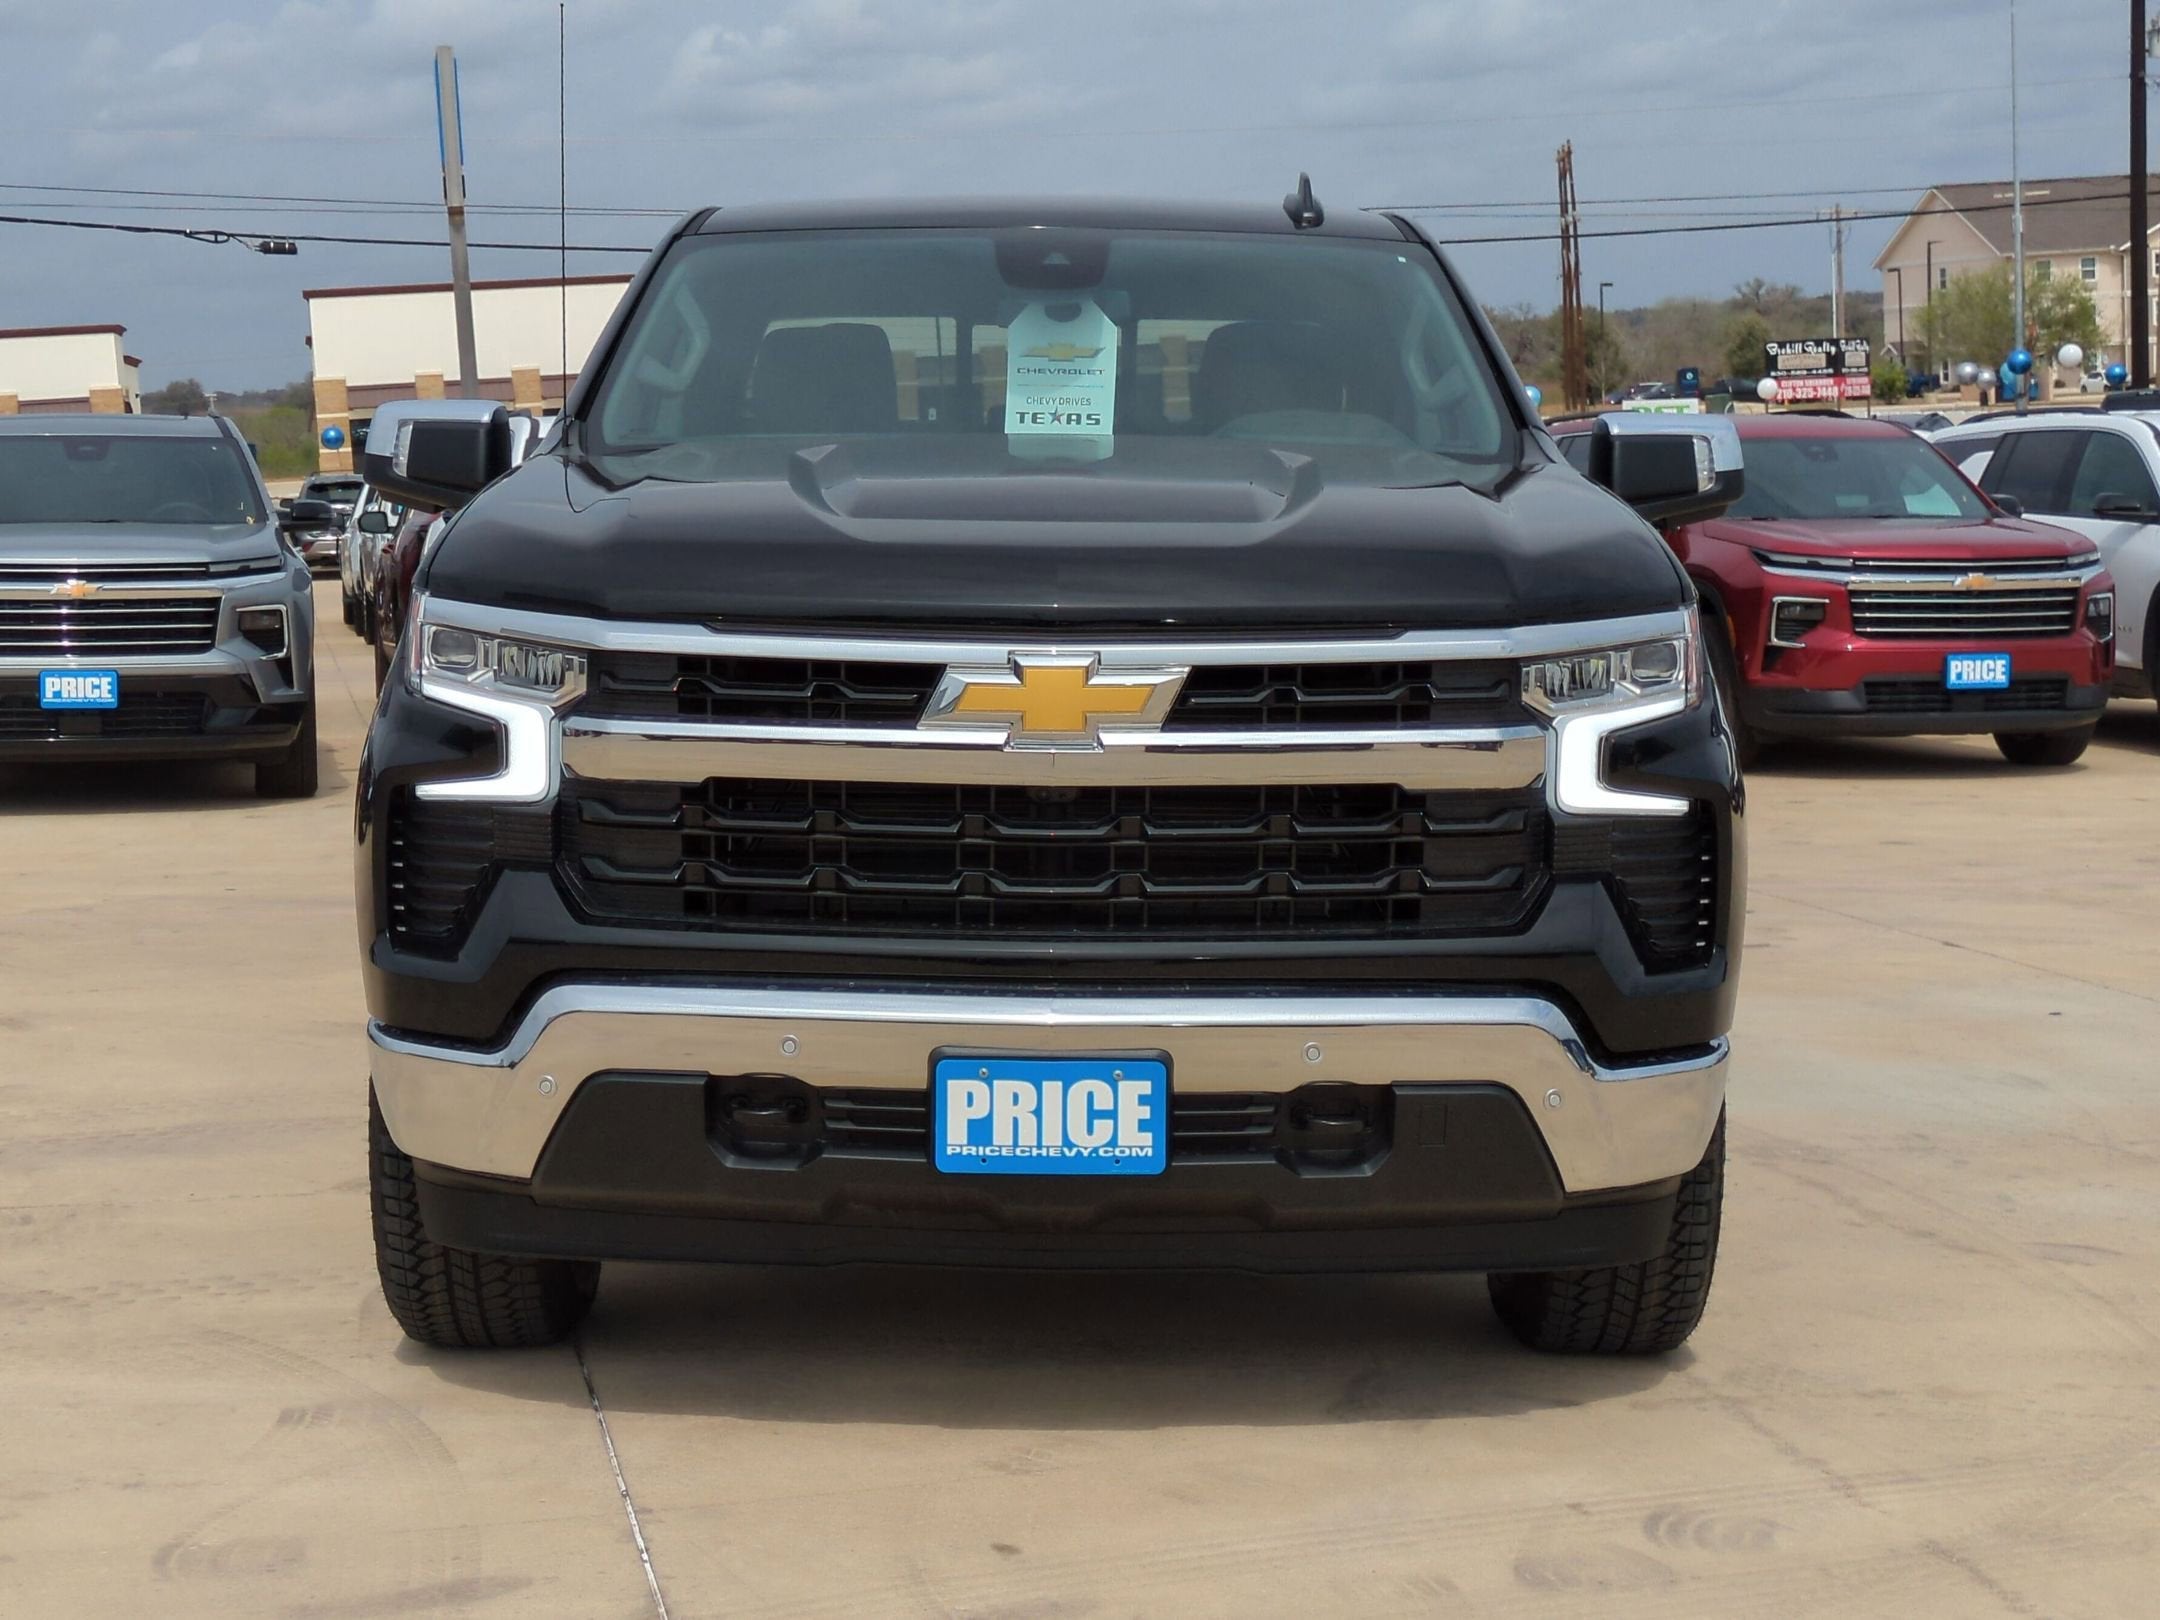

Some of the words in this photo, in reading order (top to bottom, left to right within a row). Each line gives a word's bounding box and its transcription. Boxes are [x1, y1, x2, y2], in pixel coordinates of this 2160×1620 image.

[1016, 367, 1105, 375] CHEVROLET
[1026, 396, 1057, 405] CHEVY
[1058, 396, 1092, 406] DRIVES
[1015, 406, 1101, 425] TEXAS
[1950, 659, 2007, 682] PRICE
[45, 677, 112, 698] PRICE
[946, 1079, 1153, 1148] PRICE
[946, 1146, 1153, 1157] PRICECHEVY.COM
